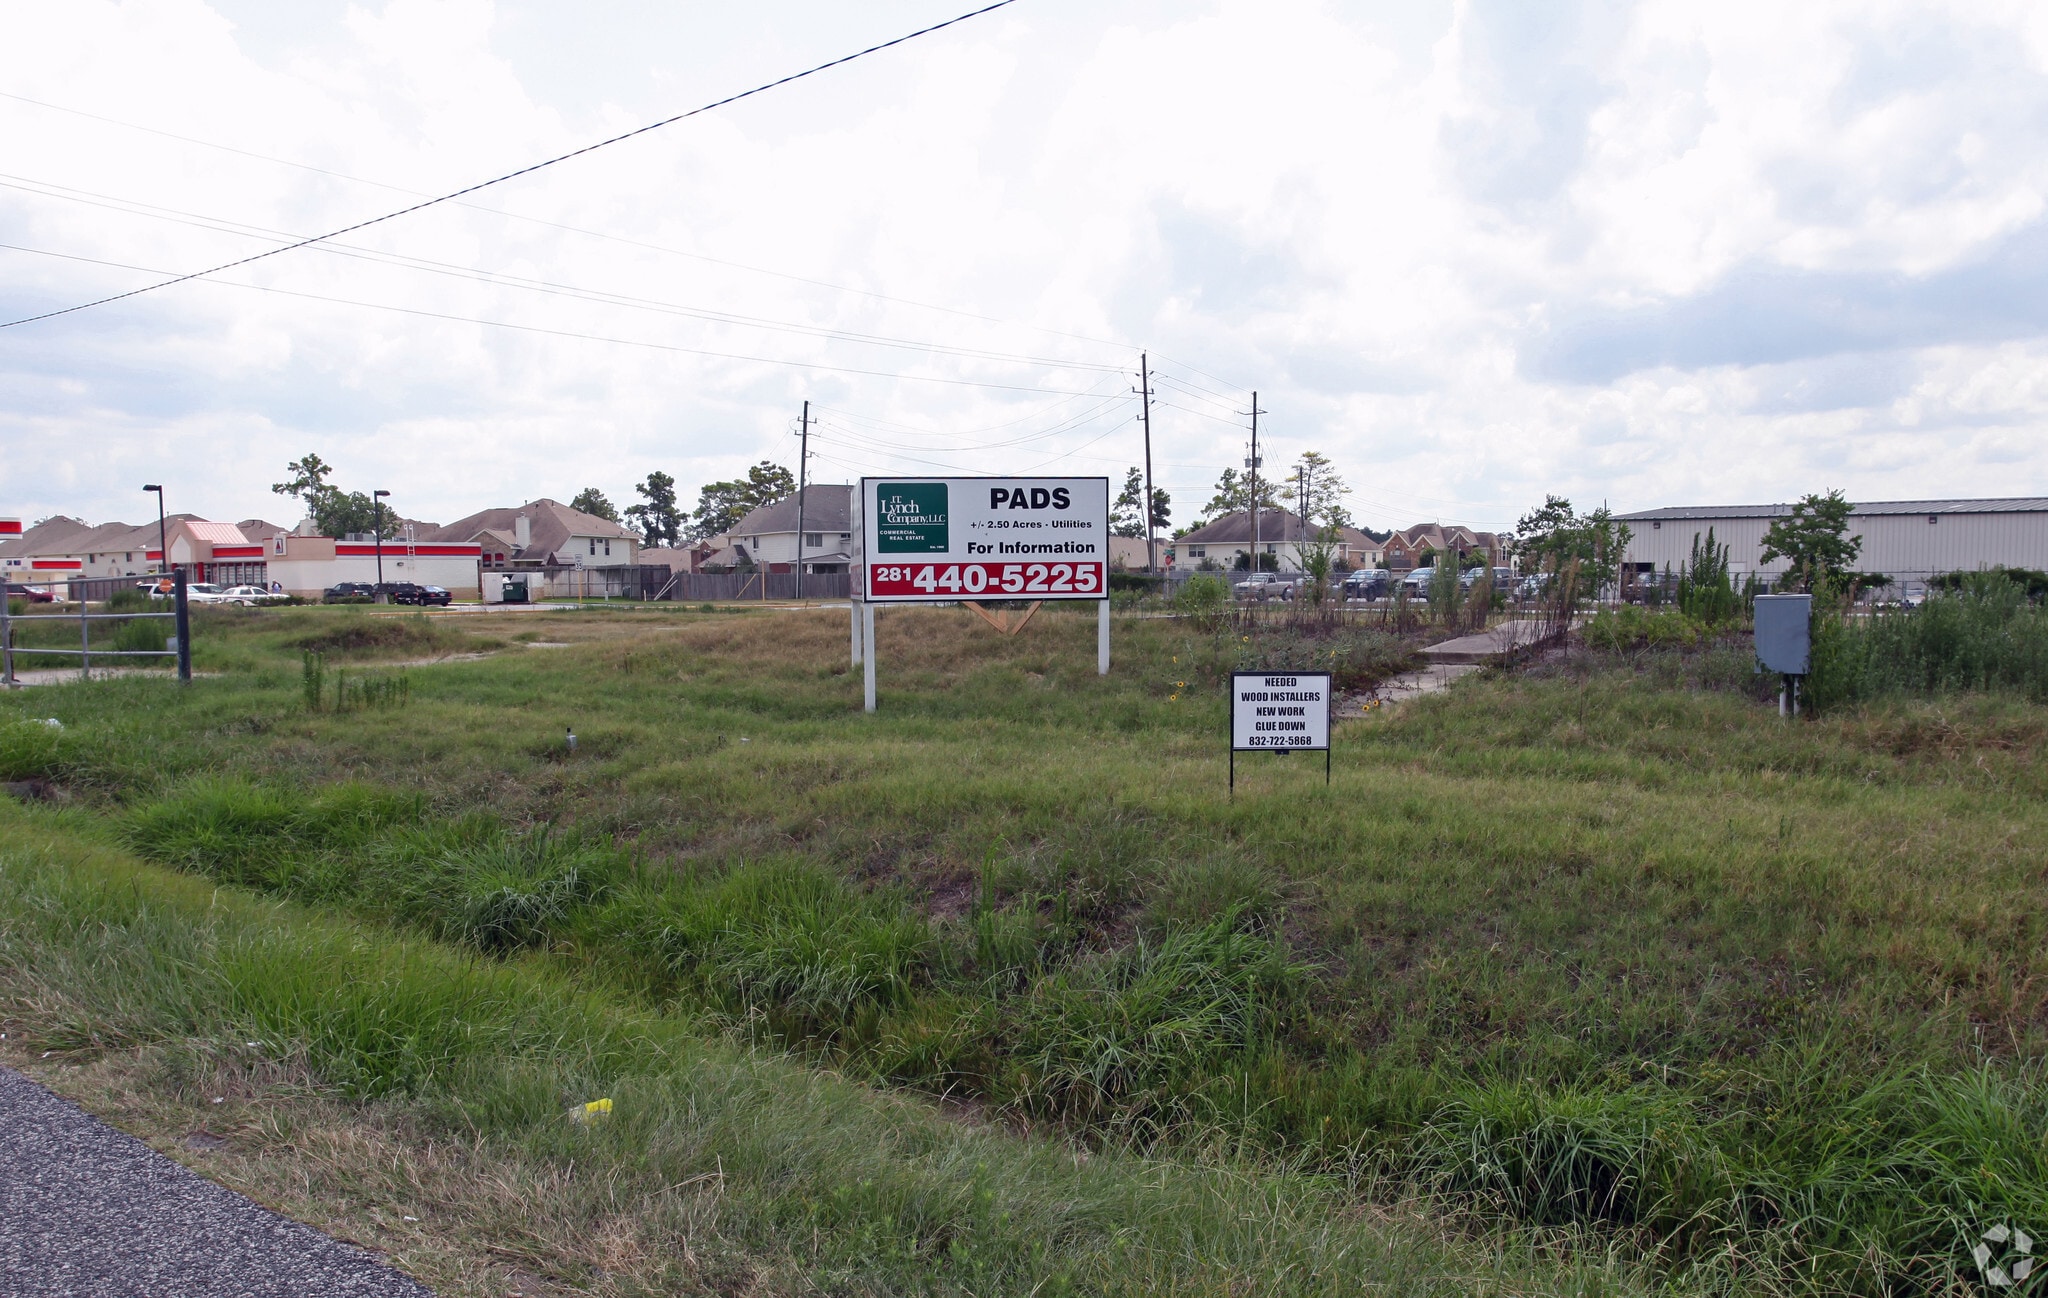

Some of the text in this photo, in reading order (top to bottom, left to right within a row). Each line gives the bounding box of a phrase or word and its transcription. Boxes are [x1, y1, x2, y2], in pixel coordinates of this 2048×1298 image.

[990, 487, 1071, 509] PADS
[880, 499, 920, 515] Lynch
[987, 520, 1010, 529] 2.50
[1012, 520, 1042, 529] Acres
[1051, 520, 1092, 529] Utilities
[967, 541, 1096, 554] For Information
[877, 567, 911, 582] 281
[913, 563, 1098, 593] 440-5225
[1264, 677, 1298, 687] NEEDED
[1241, 692, 1321, 702] WOOD INSTALLERS
[1256, 706, 1306, 717] NEW WORK
[1255, 721, 1306, 731] GLUE DOWN
[1249, 736, 1312, 746] 832-722-5868
